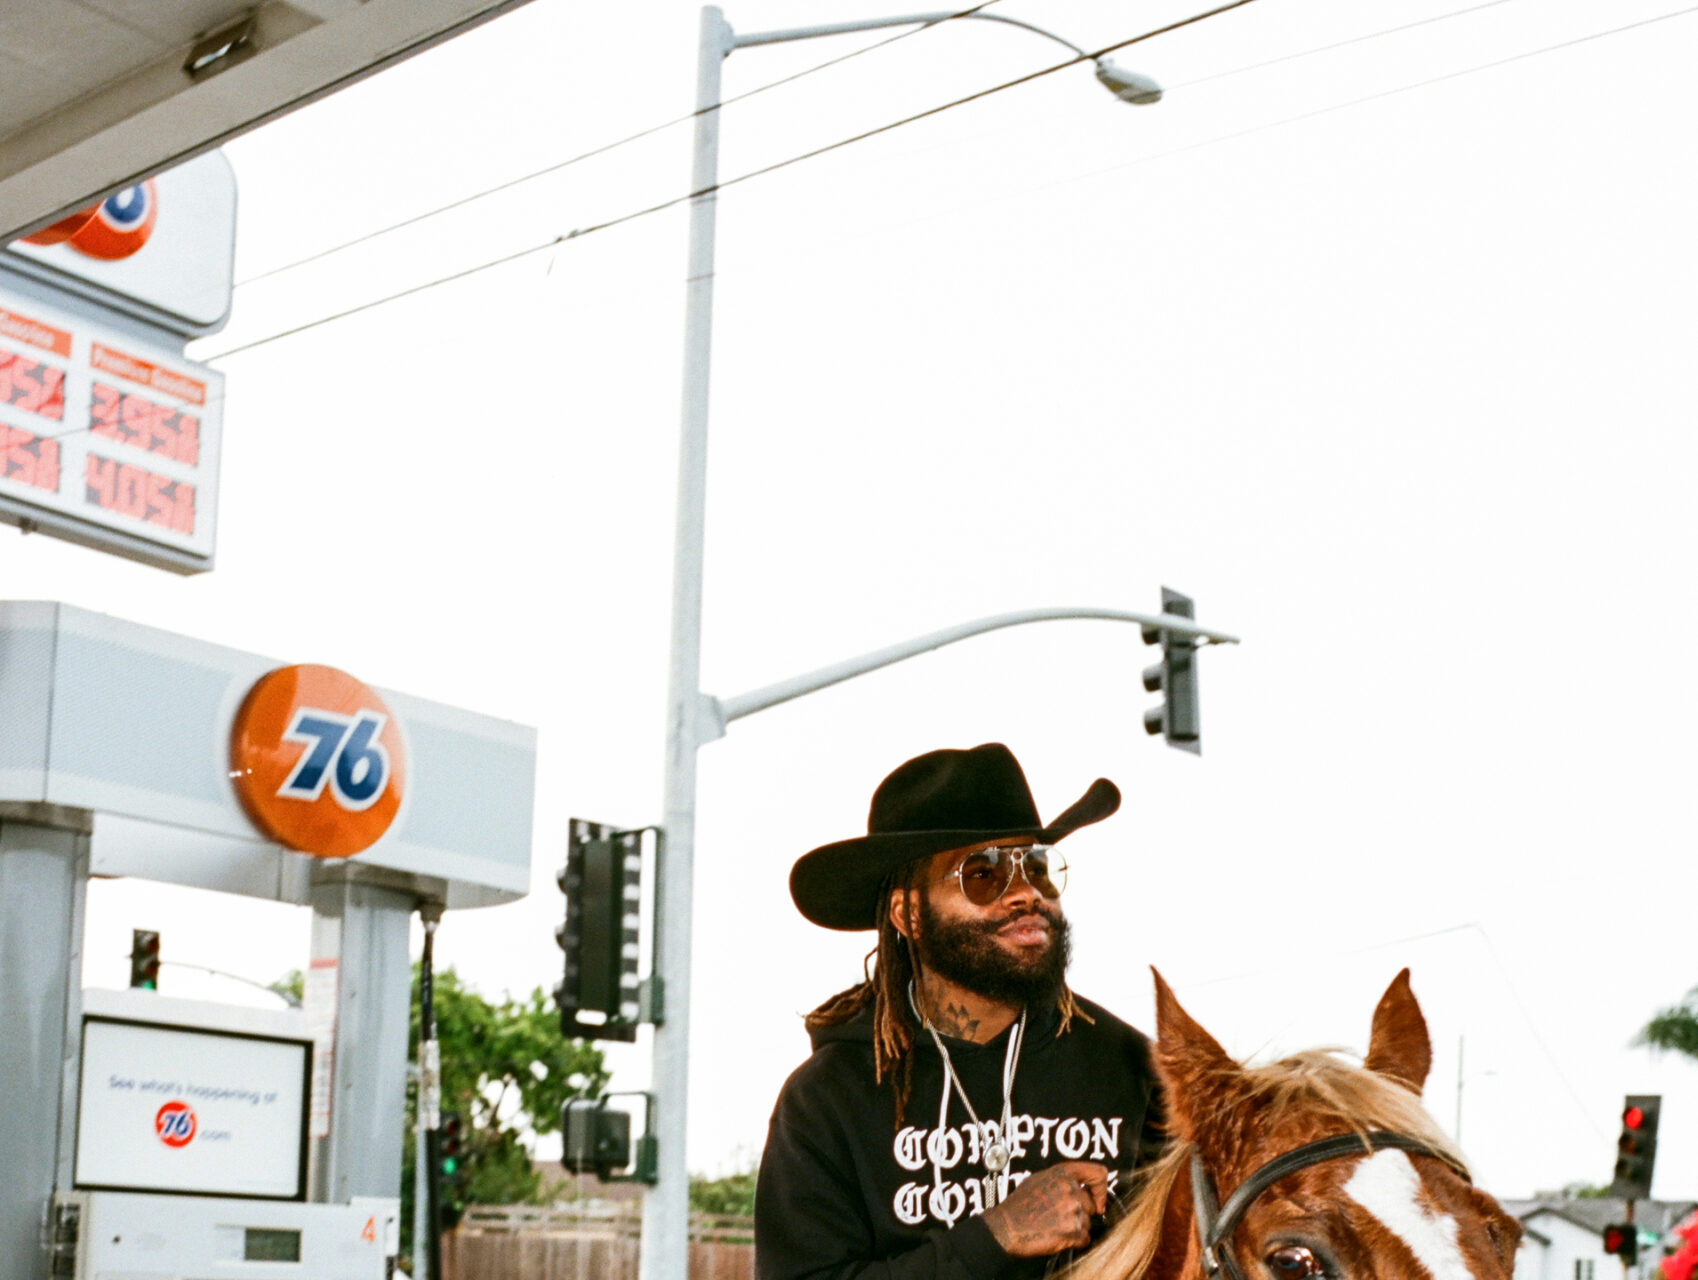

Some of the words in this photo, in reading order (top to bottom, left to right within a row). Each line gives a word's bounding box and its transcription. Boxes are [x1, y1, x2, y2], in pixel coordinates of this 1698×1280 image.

[278, 705, 389, 811] 76
[186, 1083, 261, 1106] happening
[158, 1110, 193, 1138] 76
[893, 1114, 1123, 1171] COMPTON
[361, 1216, 376, 1244] 4
